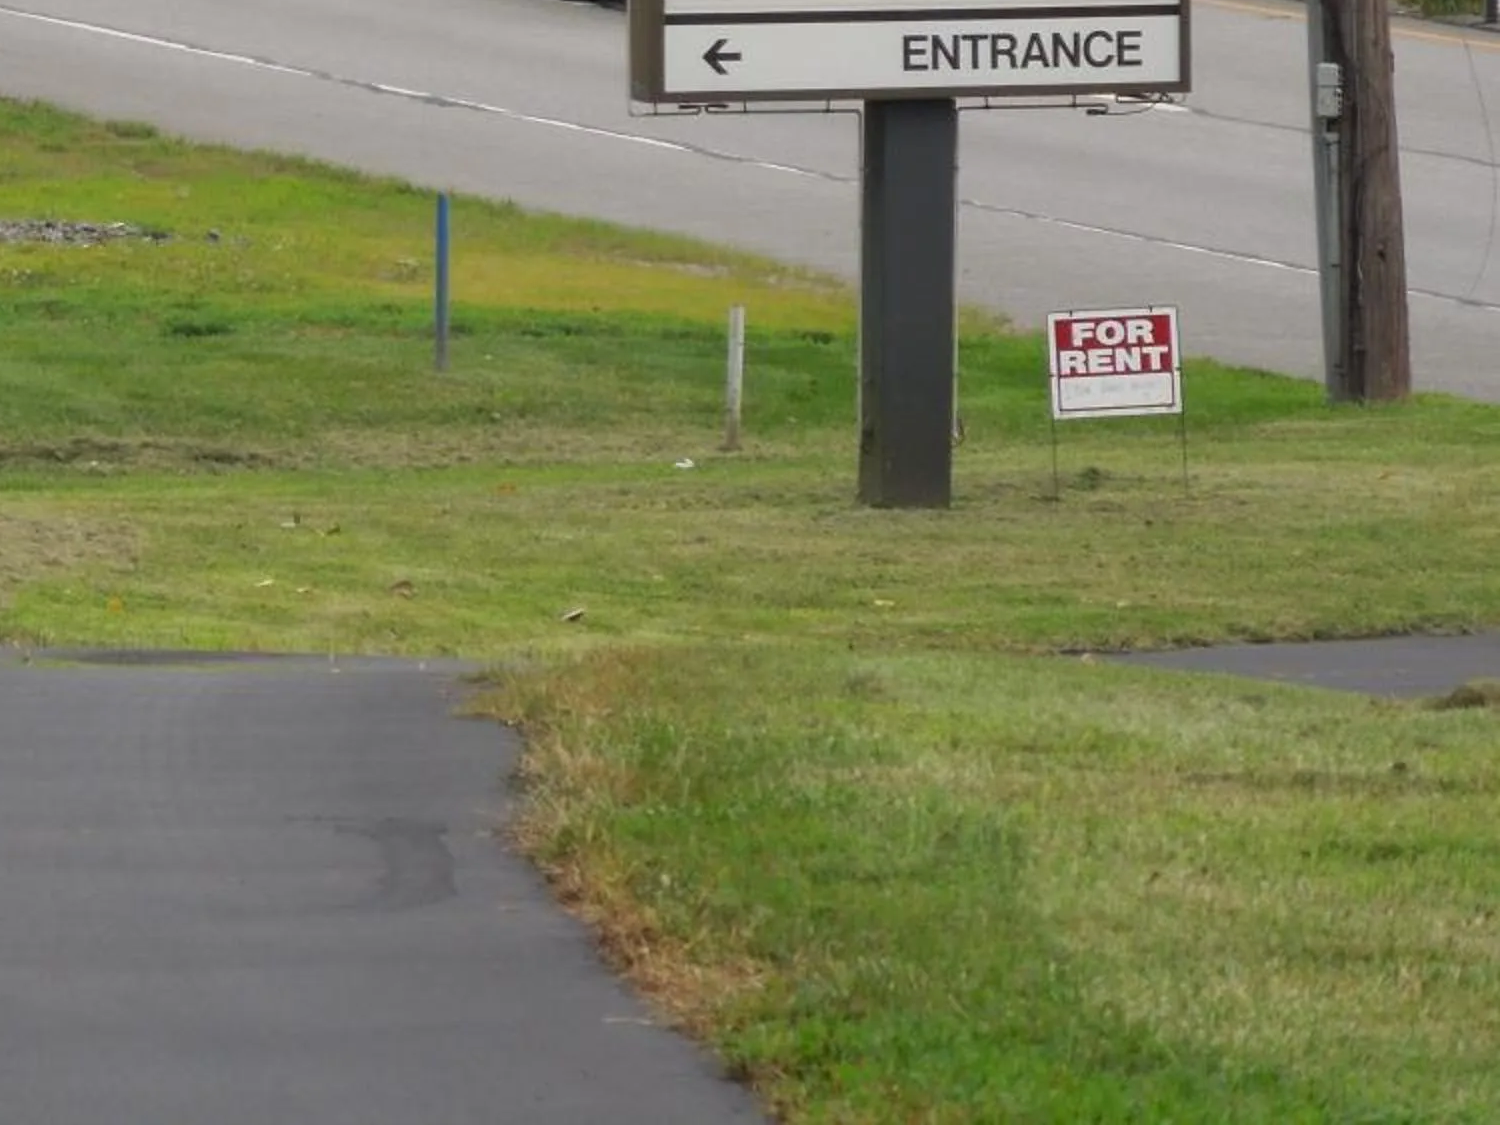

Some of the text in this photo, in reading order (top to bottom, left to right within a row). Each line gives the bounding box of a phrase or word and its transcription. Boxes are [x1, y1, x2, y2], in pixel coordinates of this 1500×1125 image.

[902, 31, 1142, 71] ENTRANCE
[1072, 320, 1155, 346] FOR
[1059, 347, 1169, 375] RENT
